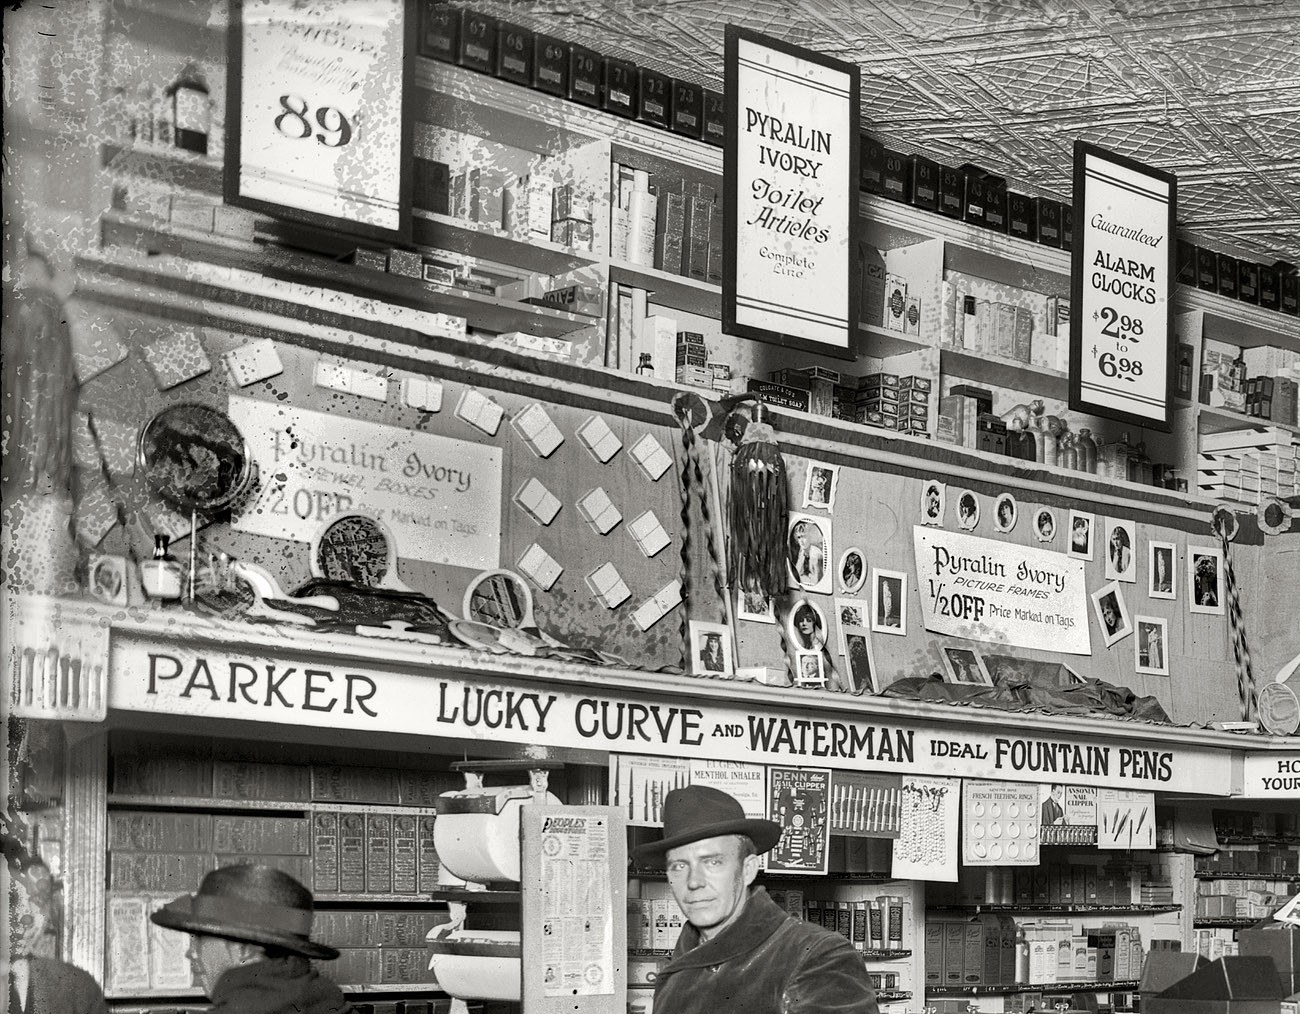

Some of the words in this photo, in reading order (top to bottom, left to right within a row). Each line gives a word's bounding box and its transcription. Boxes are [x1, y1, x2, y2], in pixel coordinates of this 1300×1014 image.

[746, 107, 831, 155] PYRALIN
[759, 145, 822, 179] IVORY
[752, 178, 824, 216] Toilet
[746, 207, 829, 243] Articles
[1090, 213, 1163, 248] Guaranteed
[759, 246, 815, 270] Complete
[1093, 250, 1155, 283] ALARM
[1092, 272, 1156, 305] CLOCKS
[1092, 306, 1144, 342] $2.98
[1091, 345, 1143, 381] $6.98
[1117, 341, 1128, 353] to
[402, 452, 472, 492] Ivory
[932, 545, 1007, 577] Pyralin
[1016, 560, 1066, 593] Ivory
[953, 576, 1005, 593] PICTURE
[1006, 584, 1050, 600] FRAMES
[989, 604, 1012, 619] Price
[1014, 608, 1043, 624] Marked
[1045, 615, 1055, 625] on
[146, 653, 378, 717] PARKER
[437, 682, 558, 733] LUCKY
[575, 699, 704, 747] CURVE
[712, 723, 744, 739] AND
[747, 715, 915, 763] WATERMAN
[930, 740, 988, 760] IDEAL
[994, 738, 1110, 776] FOUNTAIN
[1119, 749, 1174, 782] PENS
[694, 770, 729, 780] MENTHOL
[731, 771, 761, 781] INHALER
[773, 771, 808, 783] PENN
[794, 781, 826, 790] CLIPPER
[1068, 787, 1095, 795] ANSONIA
[972, 792, 993, 800] FRENCH
